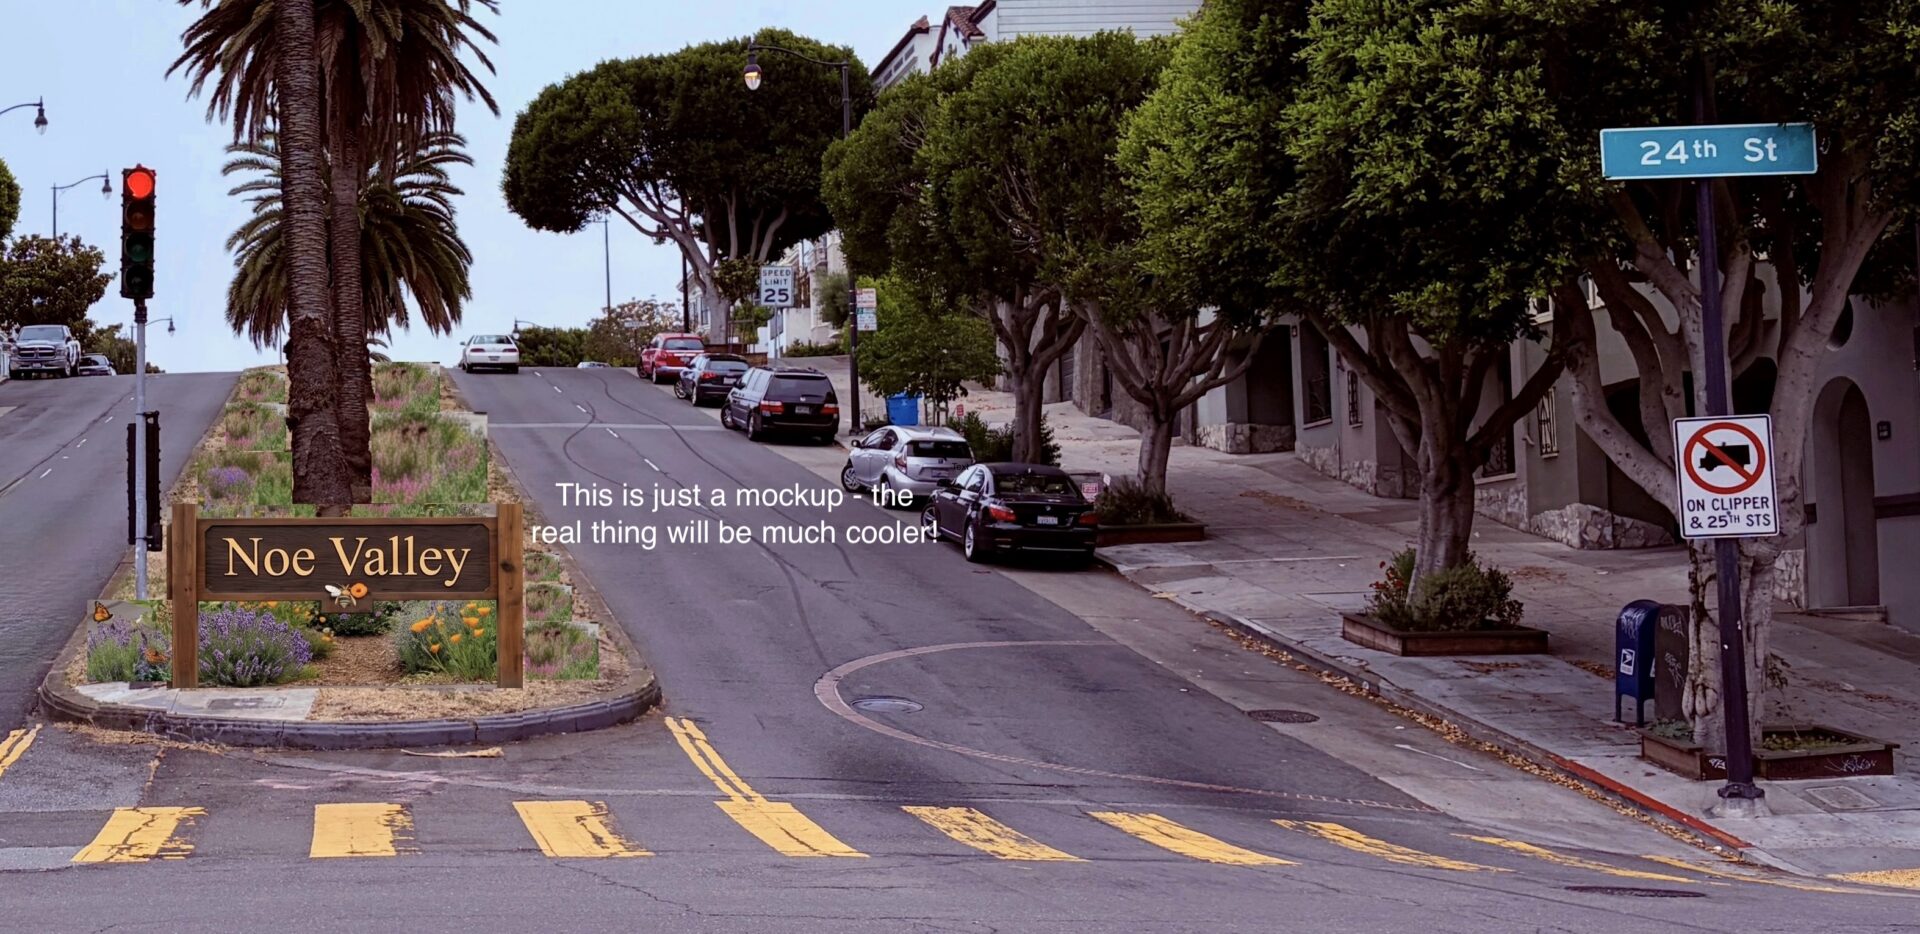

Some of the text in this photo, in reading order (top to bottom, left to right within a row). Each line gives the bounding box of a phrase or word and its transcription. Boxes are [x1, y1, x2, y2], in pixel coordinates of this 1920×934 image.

[1639, 137, 1778, 166] 24th St
[762, 269, 792, 277] SPEED
[764, 278, 788, 286] LIMIT
[764, 288, 790, 303] 25
[1686, 496, 1769, 512] ON CLIPPER
[1690, 513, 1771, 529] & 25TH STS
[222, 535, 471, 587] Noe Valley
